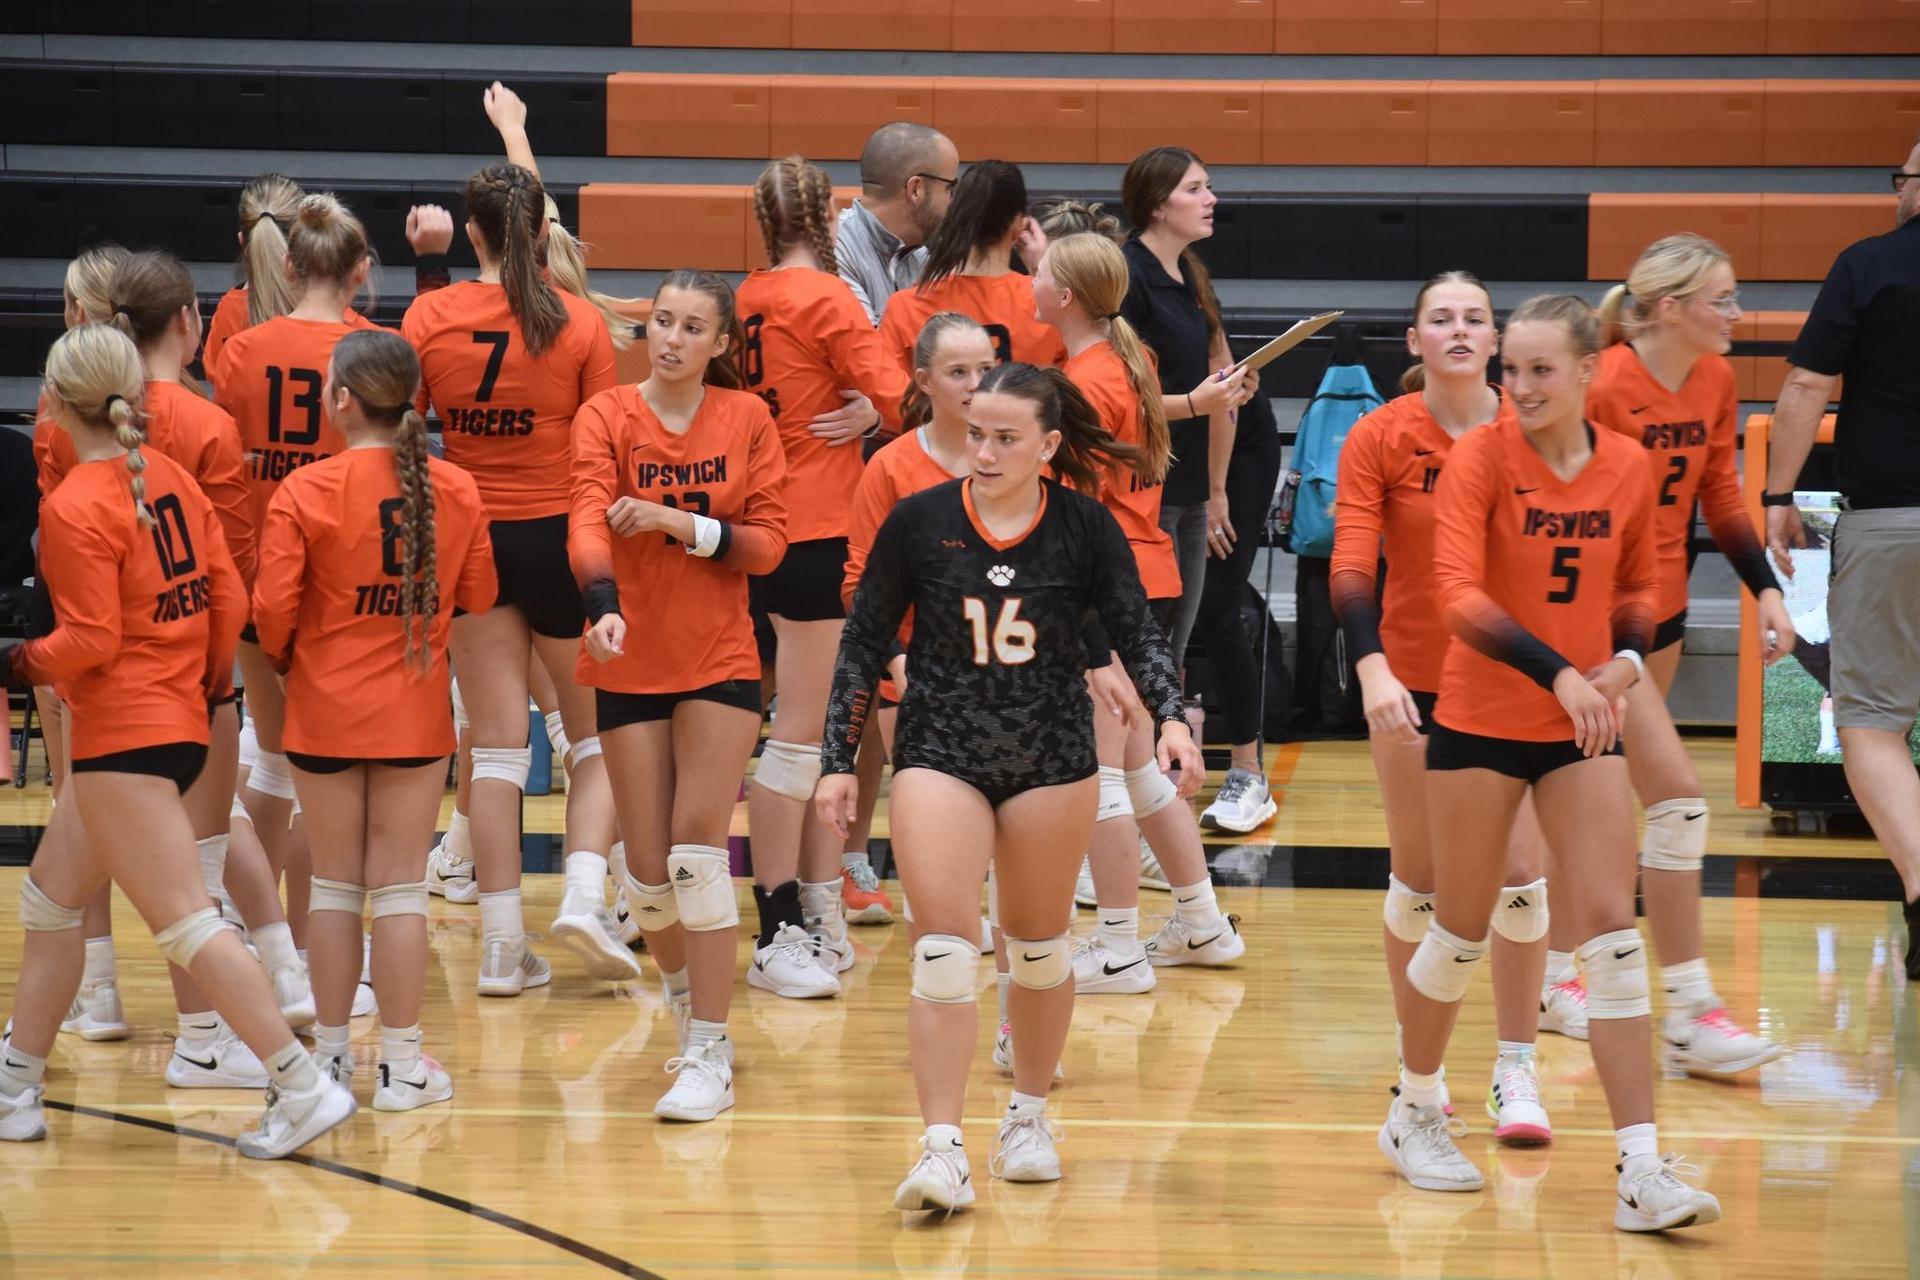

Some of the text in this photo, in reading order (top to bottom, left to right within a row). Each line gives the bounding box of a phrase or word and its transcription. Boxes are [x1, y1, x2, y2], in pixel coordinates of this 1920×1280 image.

[472, 330, 510, 403] 7
[265, 365, 323, 446] 13
[447, 408, 536, 437] TIGERS
[250, 448, 333, 482] TIGE
[638, 454, 727, 489] IPSWICH
[1658, 455, 1688, 507] 2
[143, 492, 197, 583] 10
[1523, 507, 1611, 539] IPSWICH
[1546, 546, 1581, 604] 5
[962, 595, 1037, 667] 16
